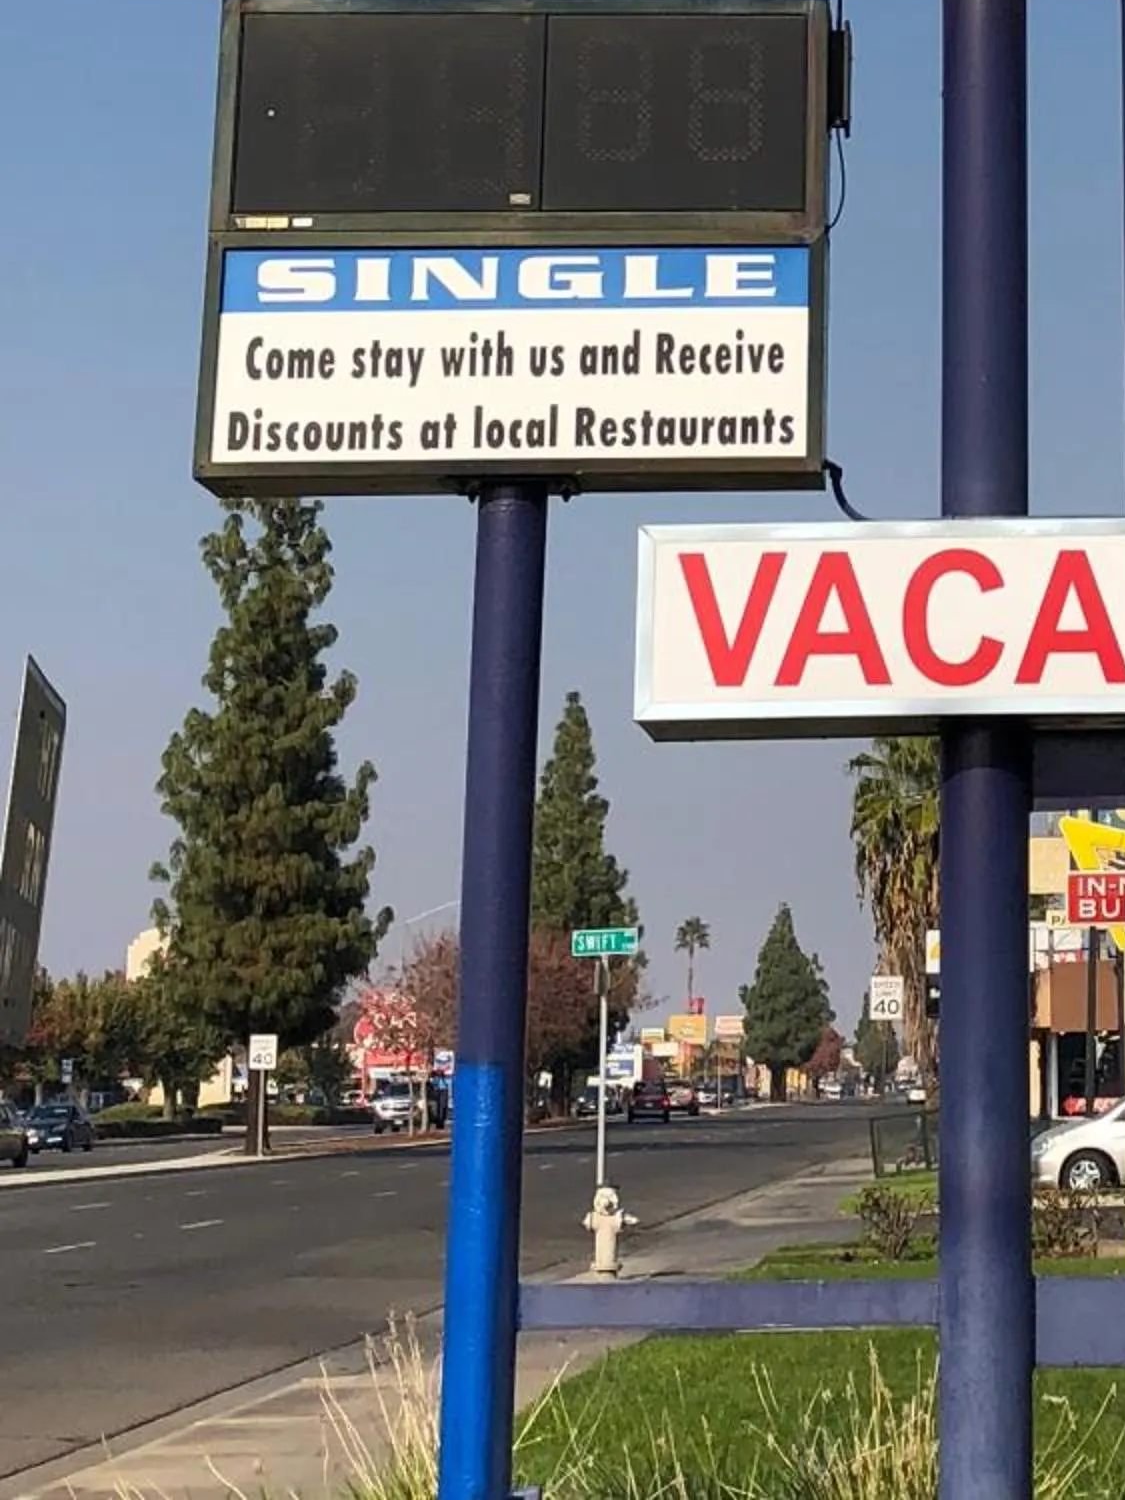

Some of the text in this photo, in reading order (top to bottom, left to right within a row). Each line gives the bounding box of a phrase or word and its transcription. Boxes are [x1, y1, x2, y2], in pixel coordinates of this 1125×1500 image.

[257, 254, 777, 304] SINGLE
[246, 330, 784, 386] Come stay with us and Receive
[227, 405, 794, 450] Discounts at local Restaurants
[576, 932, 618, 951] SWIFT
[874, 999, 900, 1015] 40
